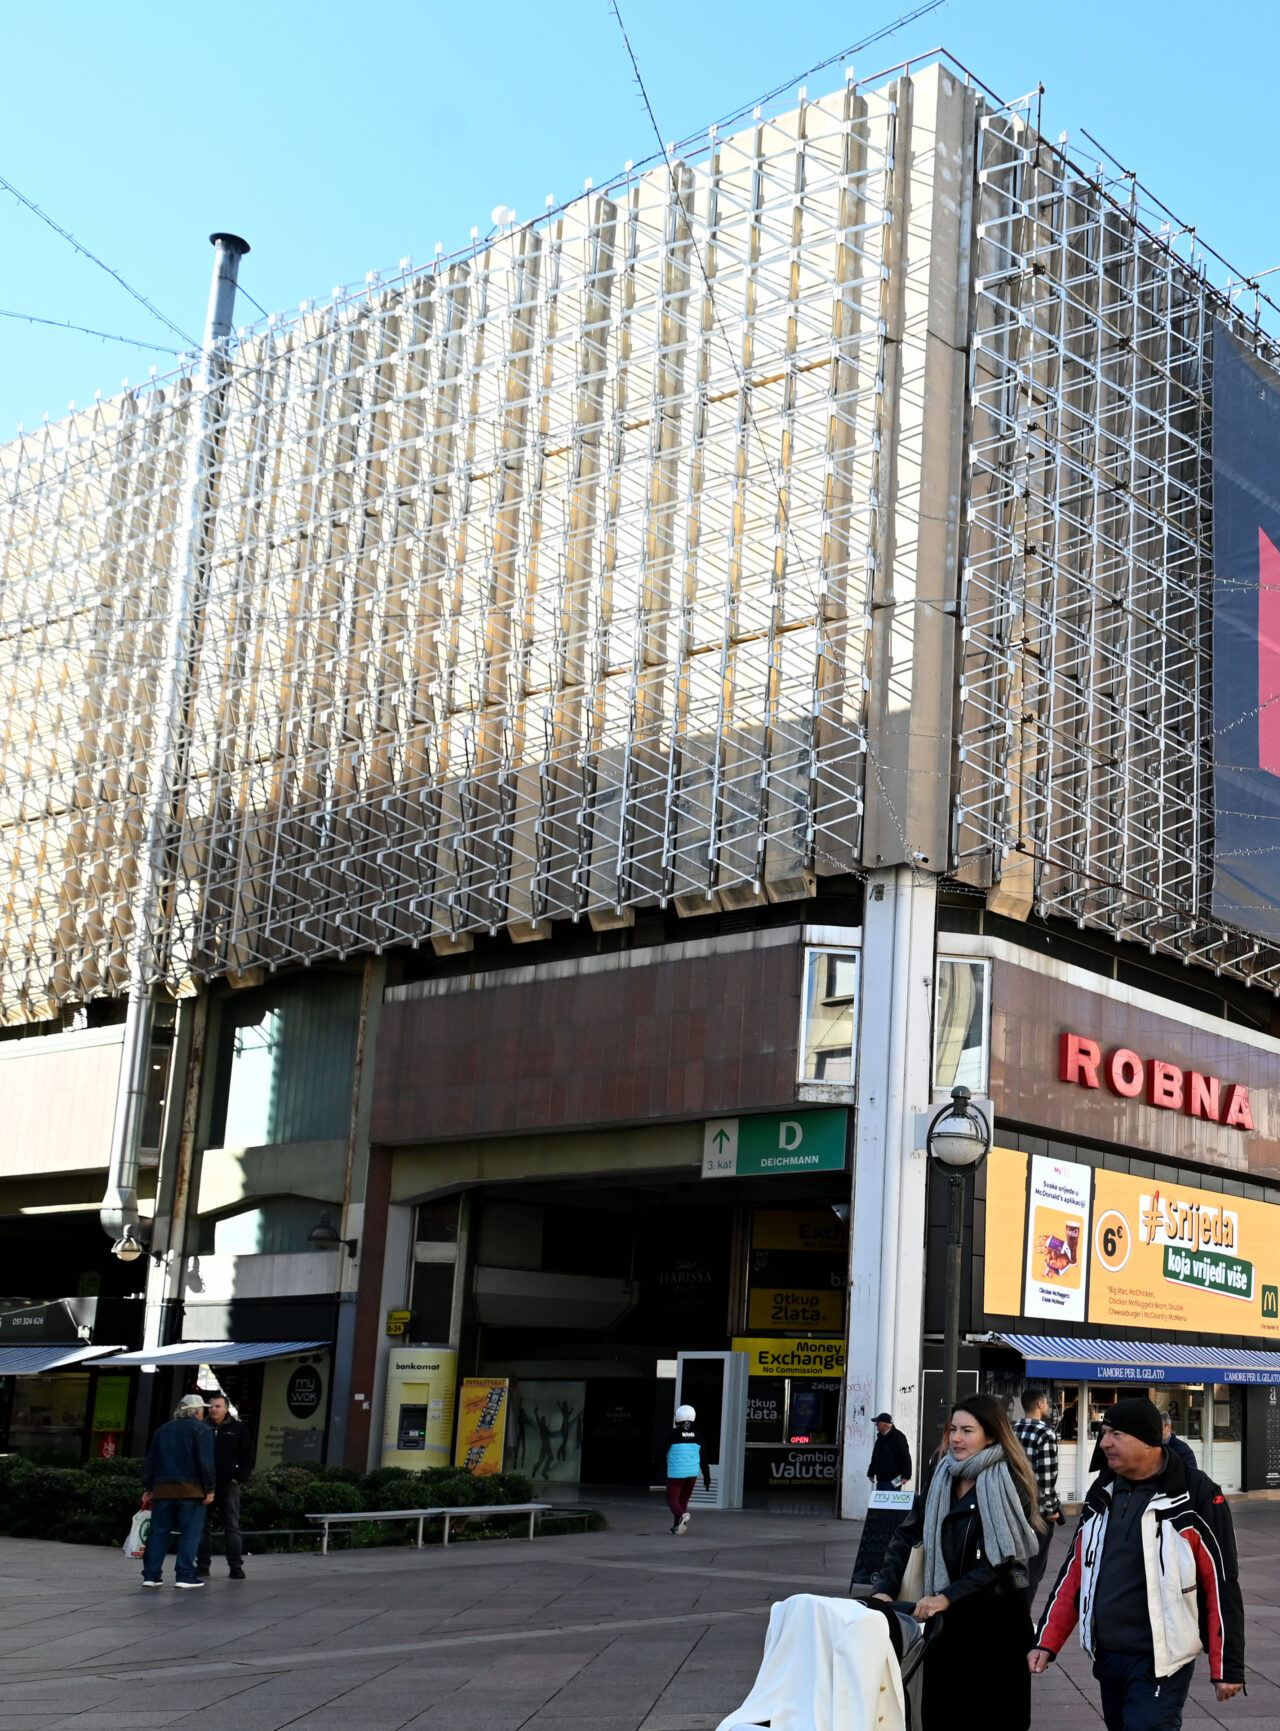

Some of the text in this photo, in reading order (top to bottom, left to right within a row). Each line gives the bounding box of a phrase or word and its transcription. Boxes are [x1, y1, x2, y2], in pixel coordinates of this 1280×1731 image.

[1060, 1032, 1254, 1131] ROBNA
[779, 1121, 803, 1150] D
[718, 1160, 732, 1169] kat
[761, 1155, 819, 1167] DEICHMANN
[1043, 1180, 1057, 1190] Svake
[1035, 1188, 1063, 1201] McDonald's
[1142, 1190, 1233, 1253] #Srijeda
[1168, 1248, 1247, 1290] koja vrijedi više
[659, 1271, 713, 1284] HARISSA
[774, 1293, 820, 1308] Otkup
[797, 1342, 841, 1355] Money
[395, 1363, 440, 1371] bankomat
[758, 1351, 844, 1370] Exchange
[776, 1366, 823, 1374] Commission
[1097, 1367, 1124, 1378] L'AMORE
[1124, 1367, 1136, 1378] PER
[1142, 1368, 1165, 1380] GELATO
[1224, 1371, 1246, 1382] L'AMORE
[1247, 1372, 1256, 1382] PER
[1262, 1373, 1280, 1383] GELATO
[295, 1379, 315, 1392] my
[746, 1408, 777, 1420] lata
[790, 1436, 810, 1444] OPEN
[788, 1450, 835, 1463] Cambio
[770, 1462, 836, 1479] Valute
[874, 1493, 911, 1504] my wok
